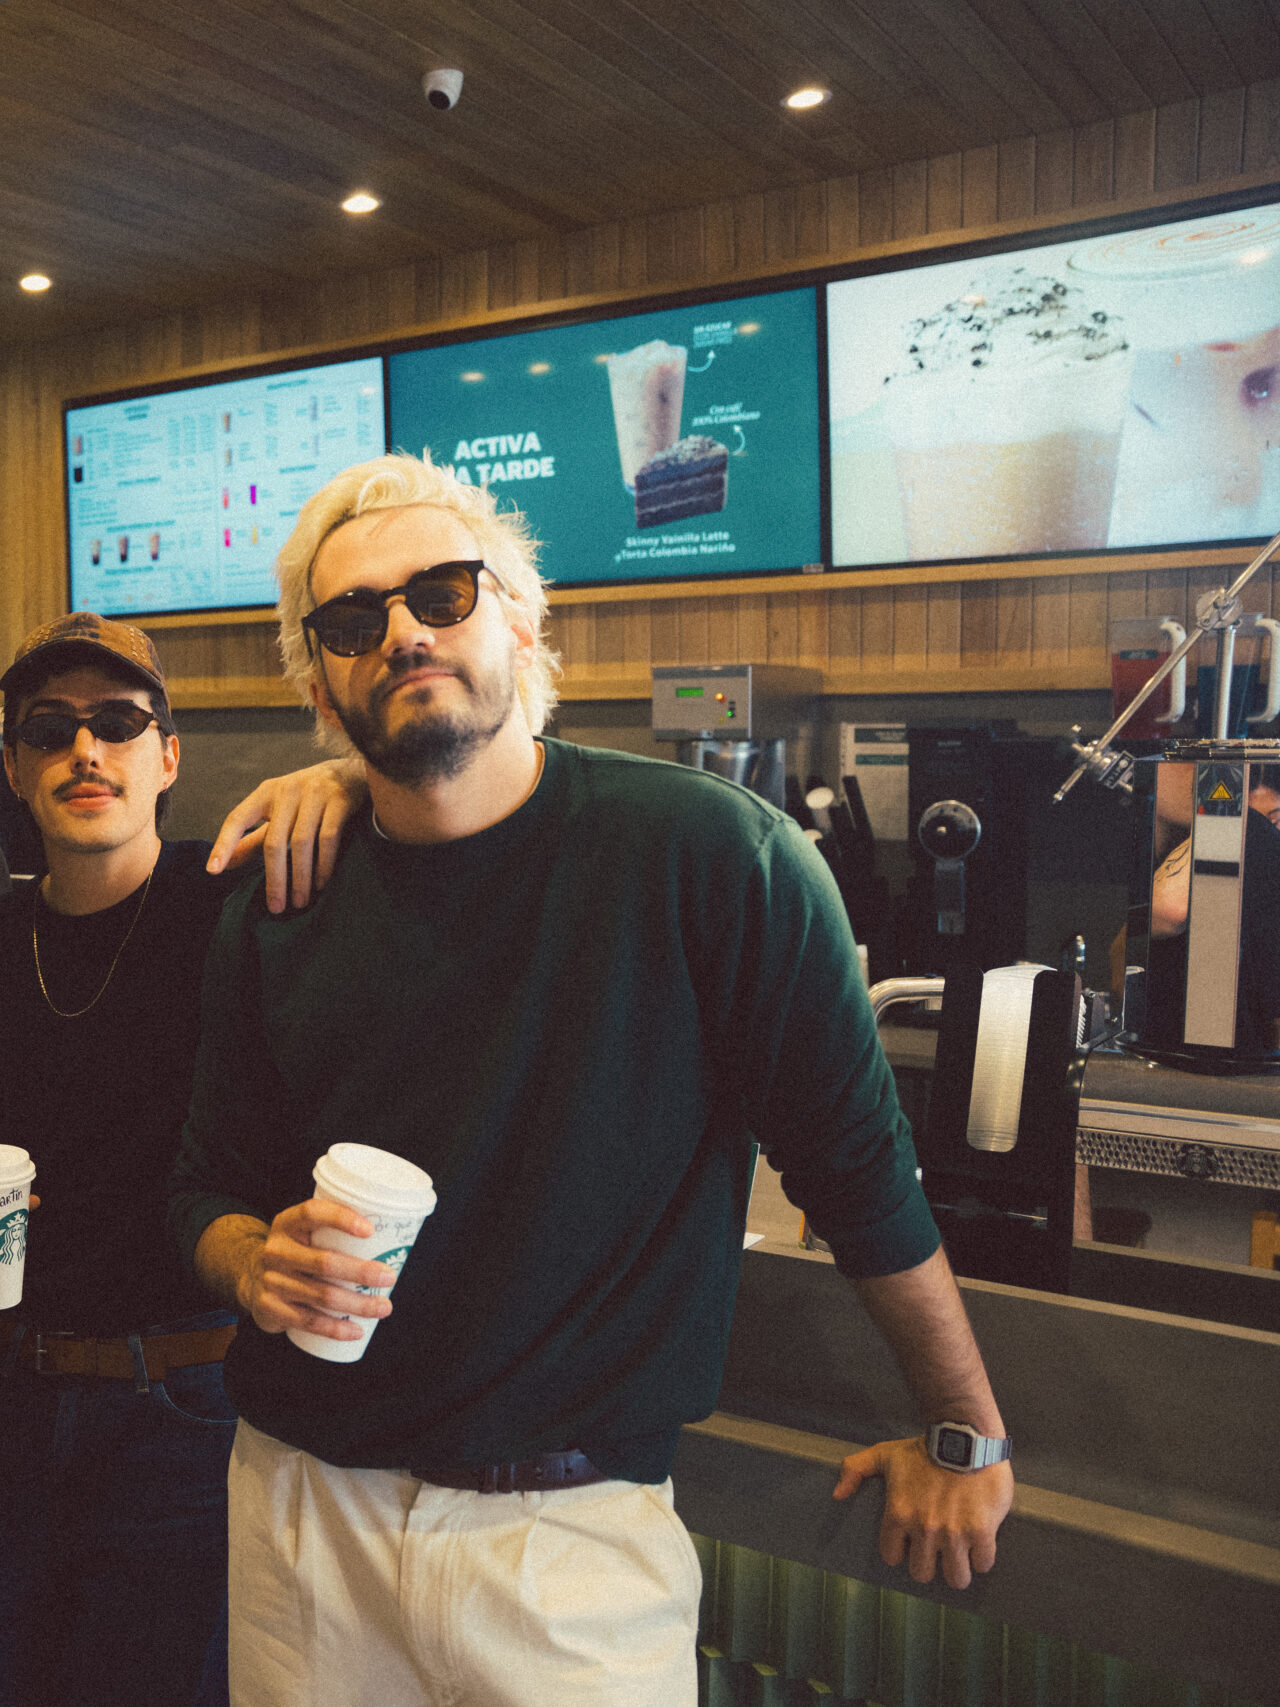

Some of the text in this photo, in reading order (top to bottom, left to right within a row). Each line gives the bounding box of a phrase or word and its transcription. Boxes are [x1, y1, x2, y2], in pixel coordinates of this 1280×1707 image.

[454, 432, 541, 461] ACTIVA
[476, 456, 556, 483] TARDE
[625, 536, 660, 548] Skinny
[701, 531, 730, 541] Latte
[649, 547, 698, 557] Colombia
[699, 542, 736, 553] Nariño
